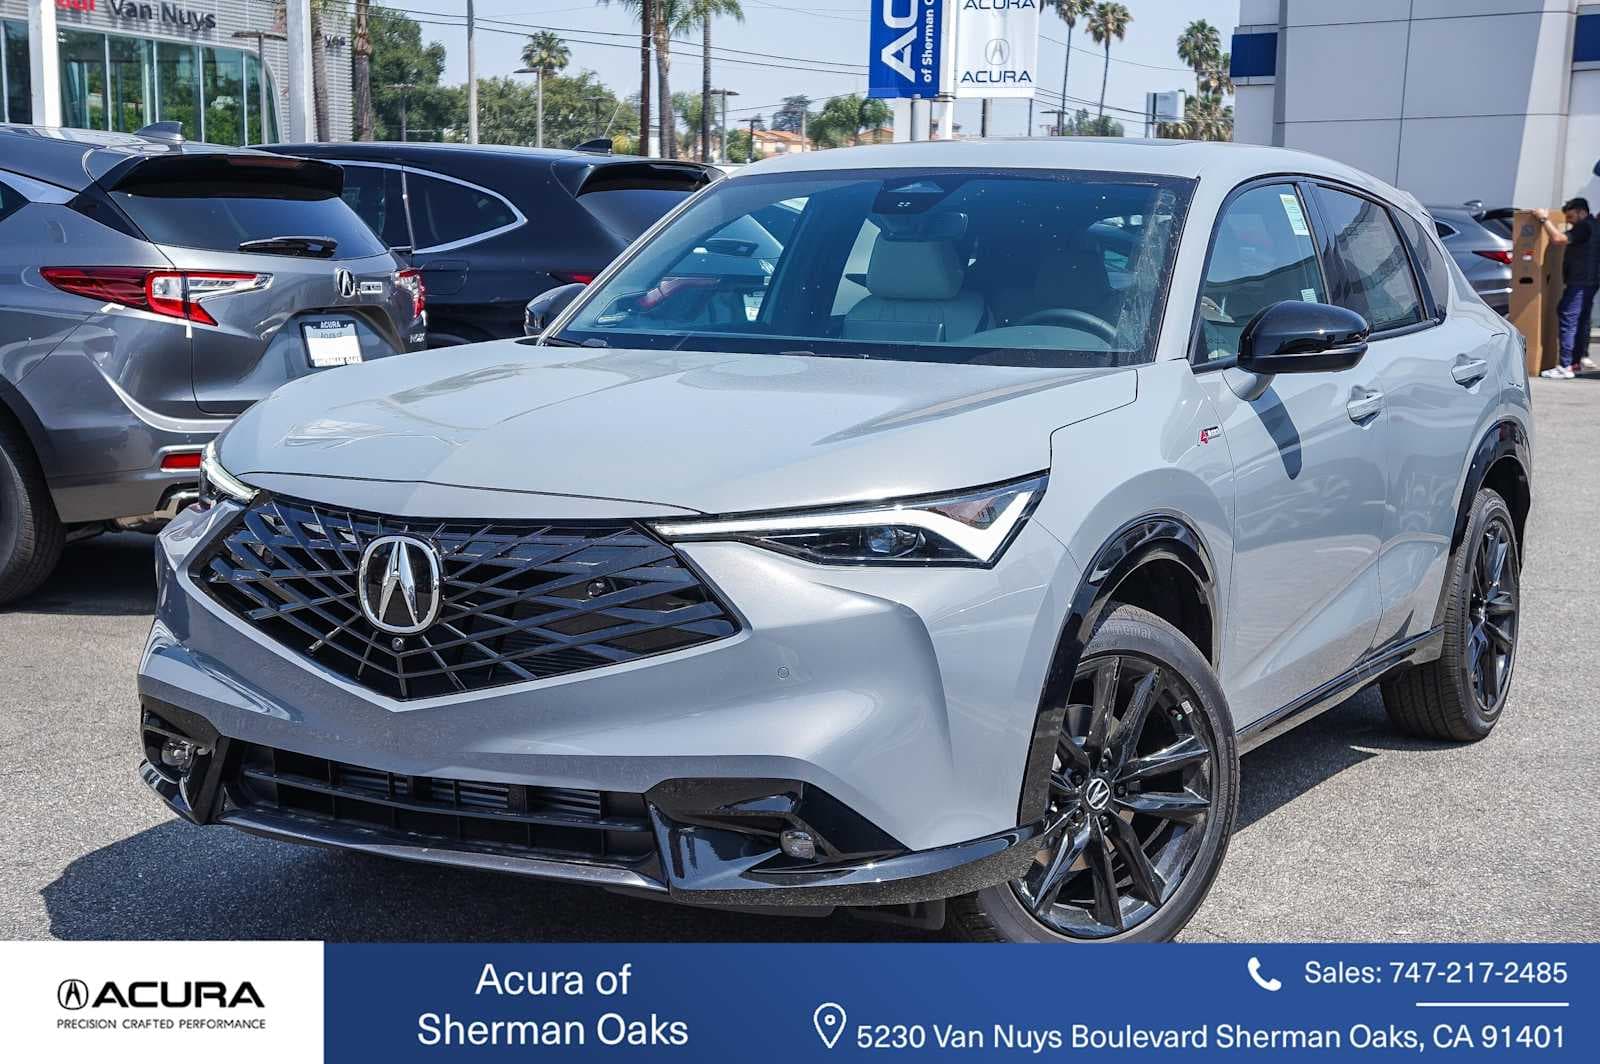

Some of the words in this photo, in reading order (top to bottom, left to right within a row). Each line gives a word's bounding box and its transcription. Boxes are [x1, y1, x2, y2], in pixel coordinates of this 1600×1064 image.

[962, 0, 1036, 9] ACURA
[109, 0, 153, 20] Van
[161, 1, 217, 31] Nuys
[922, 12, 935, 66] Sherman
[921, 69, 932, 82] of
[960, 70, 1032, 83] ACURA
[320, 320, 341, 329] ACURA
